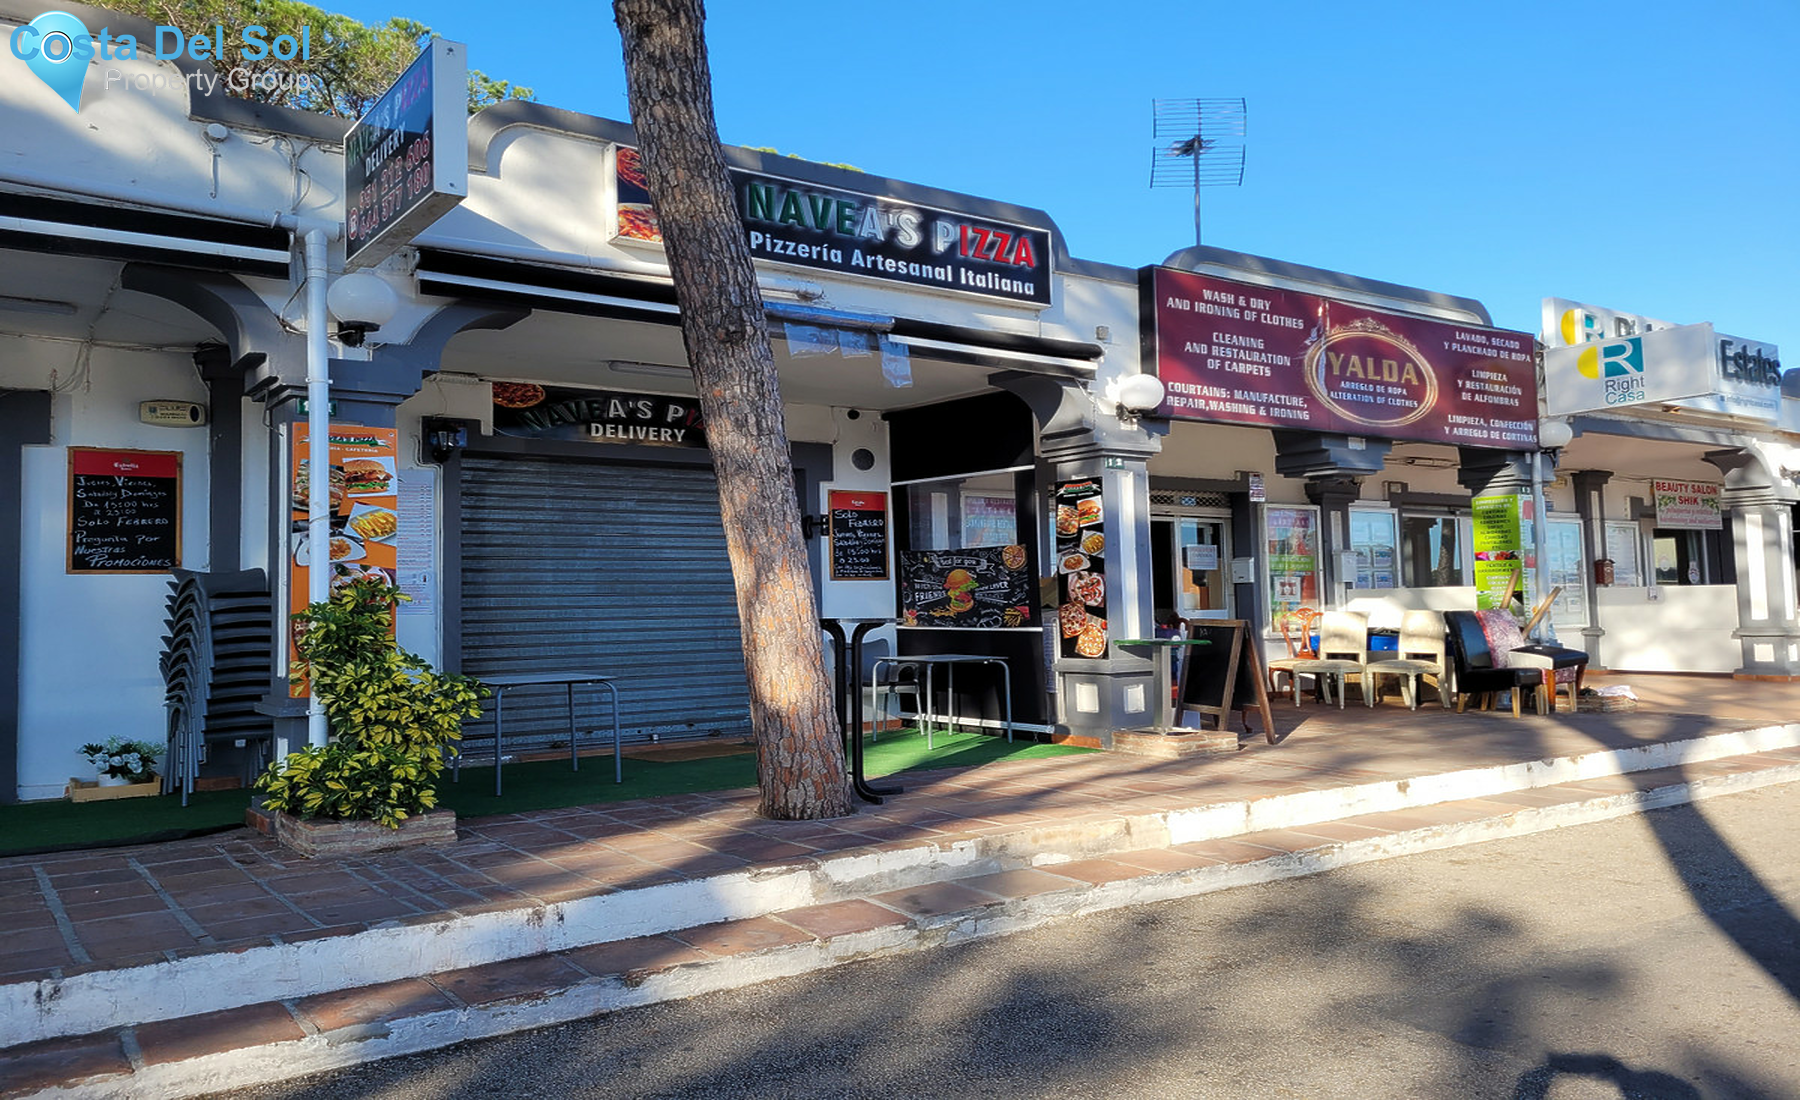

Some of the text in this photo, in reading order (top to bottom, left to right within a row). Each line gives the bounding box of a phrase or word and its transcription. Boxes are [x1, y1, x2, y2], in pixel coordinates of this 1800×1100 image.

[365, 121, 406, 178] DELIVERY
[749, 183, 1036, 269] NAVEA'S PIZZA
[750, 230, 1035, 296] Pizzería Artesanal Italiana
[1203, 289, 1271, 310] WASH & DRY
[1167, 297, 1304, 329] AND IRONING OF CLOTHES
[1213, 332, 1264, 349] CLEANING
[1456, 331, 1520, 349] LAVADO, SECADO
[1185, 341, 1291, 366] AND RESTAURATION
[1443, 341, 1531, 362] Y PLANCHADO DE ROPA
[1207, 358, 1271, 377] OF CARPETS
[1327, 351, 1419, 385] YALDA
[1720, 339, 1782, 387] Estates
[1472, 369, 1508, 382] LIMPIEZA
[1341, 381, 1407, 396] ARREGLO DE ROPA
[1457, 380, 1522, 395] Y RESTAURACIÓN
[1605, 376, 1645, 393] Right
[1168, 382, 1308, 408] COURTAINS: MANUFACTURE,
[1330, 391, 1418, 408] ALTERATION OF CLOTHES
[1462, 392, 1519, 406] DE ALFOMBRAS
[1605, 390, 1645, 405] Casa
[1259, 406, 1267, 416] &
[1270, 407, 1310, 420] IRONING
[1448, 414, 1487, 427] LIMPIEZA,
[590, 422, 686, 442] DELIVERY
[1444, 426, 1537, 443] Y ARREGLO DE CORTINAS
[1656, 481, 1718, 495] BEAUTY SALON
[1678, 496, 1699, 506] SHIK
